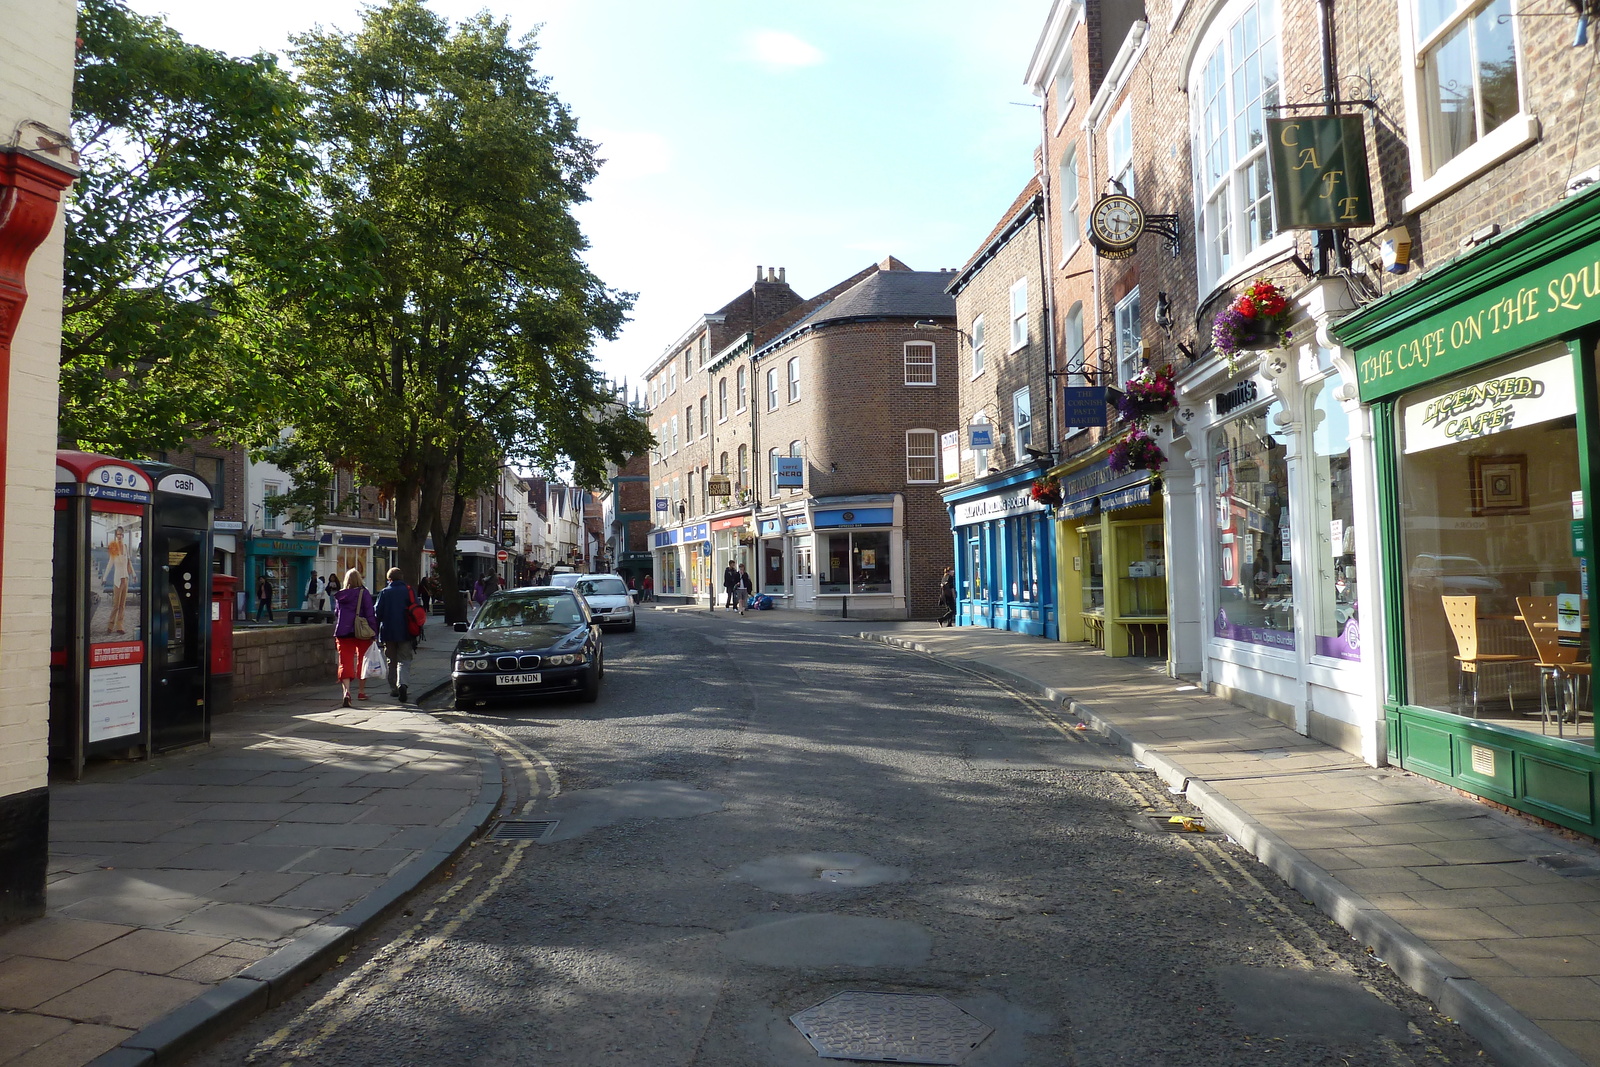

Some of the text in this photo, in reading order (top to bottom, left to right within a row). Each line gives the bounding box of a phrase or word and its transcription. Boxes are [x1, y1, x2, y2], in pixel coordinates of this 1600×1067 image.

[1280, 124, 1359, 220] CAFE
[1100, 248, 1134, 257] BARNITTS
[1360, 349, 1394, 384] THE
[1397, 328, 1446, 370] CAFE
[1450, 310, 1484, 349] ON
[1488, 287, 1540, 335] THE
[1421, 376, 1533, 426] LICENSED
[174, 479, 194, 492] cash
[1262, 632, 1276, 644] Open
[522, 674, 538, 682] NDN
